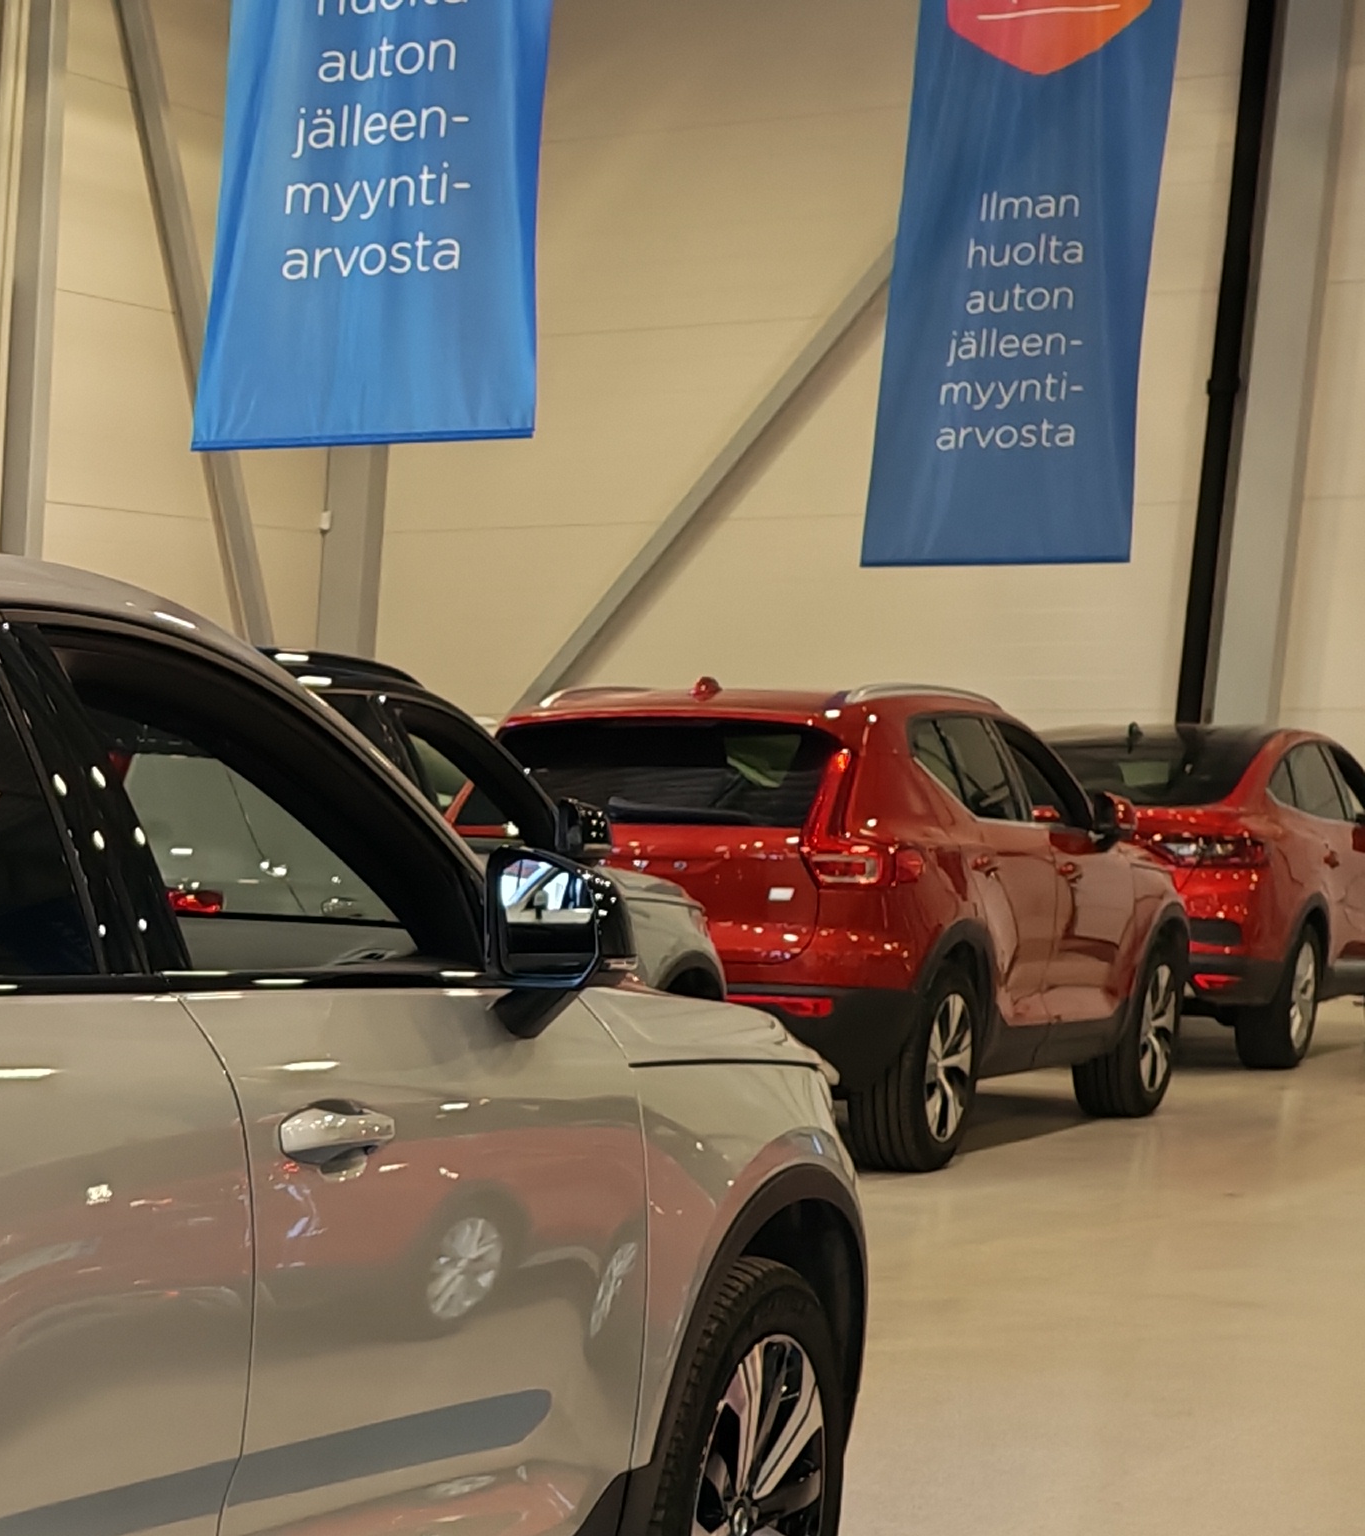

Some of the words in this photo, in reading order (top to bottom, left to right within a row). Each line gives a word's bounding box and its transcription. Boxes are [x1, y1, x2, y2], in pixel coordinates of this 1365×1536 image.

[317, 36, 457, 83] auton
[291, 104, 470, 159] jälleen-
[284, 162, 471, 222] myynti-
[979, 191, 1080, 222] Ilman
[281, 231, 461, 280] arvosta
[967, 233, 1085, 269] huolta
[965, 283, 1075, 315] auton
[946, 329, 1084, 367] jälleen-
[939, 371, 1085, 411] myynti-
[935, 418, 1077, 451] arvosta
